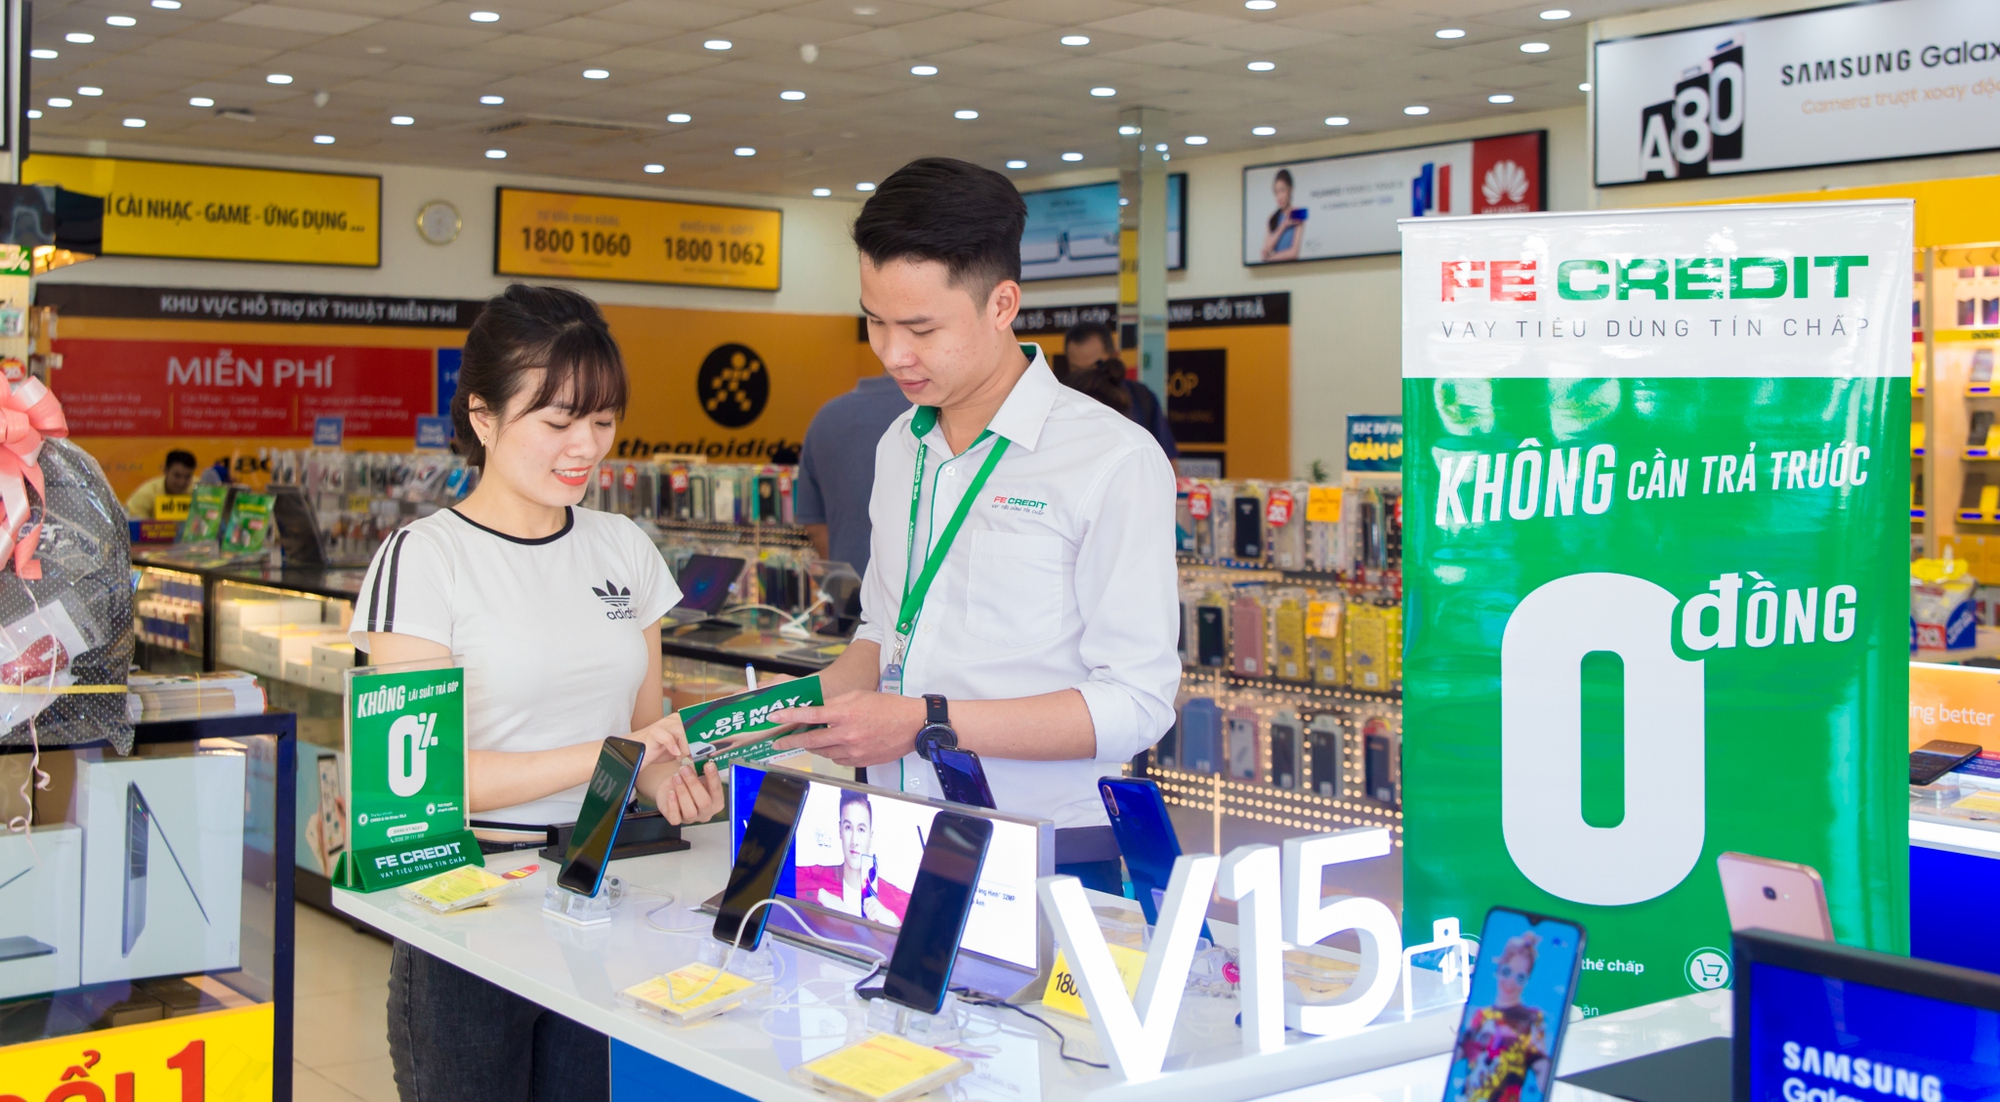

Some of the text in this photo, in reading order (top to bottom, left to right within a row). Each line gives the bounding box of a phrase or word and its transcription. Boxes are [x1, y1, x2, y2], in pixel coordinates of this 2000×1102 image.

[1781, 50, 1911, 86] SAMSUNG
[1801, 94, 1871, 115] Camera
[1875, 88, 1919, 108] trượt
[1922, 83, 1968, 102] xoay
[1640, 60, 1744, 179] A80
[115, 193, 142, 218] CÀI
[147, 198, 192, 226] NHẠC
[204, 203, 251, 226] GAME
[264, 203, 299, 228] ỨNG
[303, 209, 347, 235] DỤNG
[521, 226, 631, 258] 1800 1060
[664, 236, 765, 266] 1800 1062
[1441, 255, 1869, 301] FE CREDIT
[160, 294, 198, 314] KHU
[202, 298, 239, 318] VỰC
[332, 301, 386, 324] THUẬT
[429, 302, 457, 322] PHÍ
[1441, 319, 1498, 339] VAY
[1516, 315, 1587, 338] TIÊU
[1605, 316, 1690, 338] DÙNG
[1709, 314, 1763, 337] TÍN
[166, 348, 336, 389] MIỄN PHÍ
[1434, 437, 1872, 527] KHÔNG CẦN TRẢ TRƯỚC
[993, 496, 1047, 510] FE CREDIT
[357, 684, 406, 719] KHÔNG
[1939, 702, 1996, 727] better
[699, 719, 746, 740] VỌT
[1501, 572, 1706, 907] 0
[375, 841, 461, 869] FE CREDIT
[380, 871, 394, 879] VAY
[435, 859, 447, 867] TÍN
[1036, 826, 1402, 1081] V15
[1606, 959, 1644, 976] chấp
[1056, 971, 1082, 998] 180
[1782, 1040, 1943, 1102] SAMSUNG
